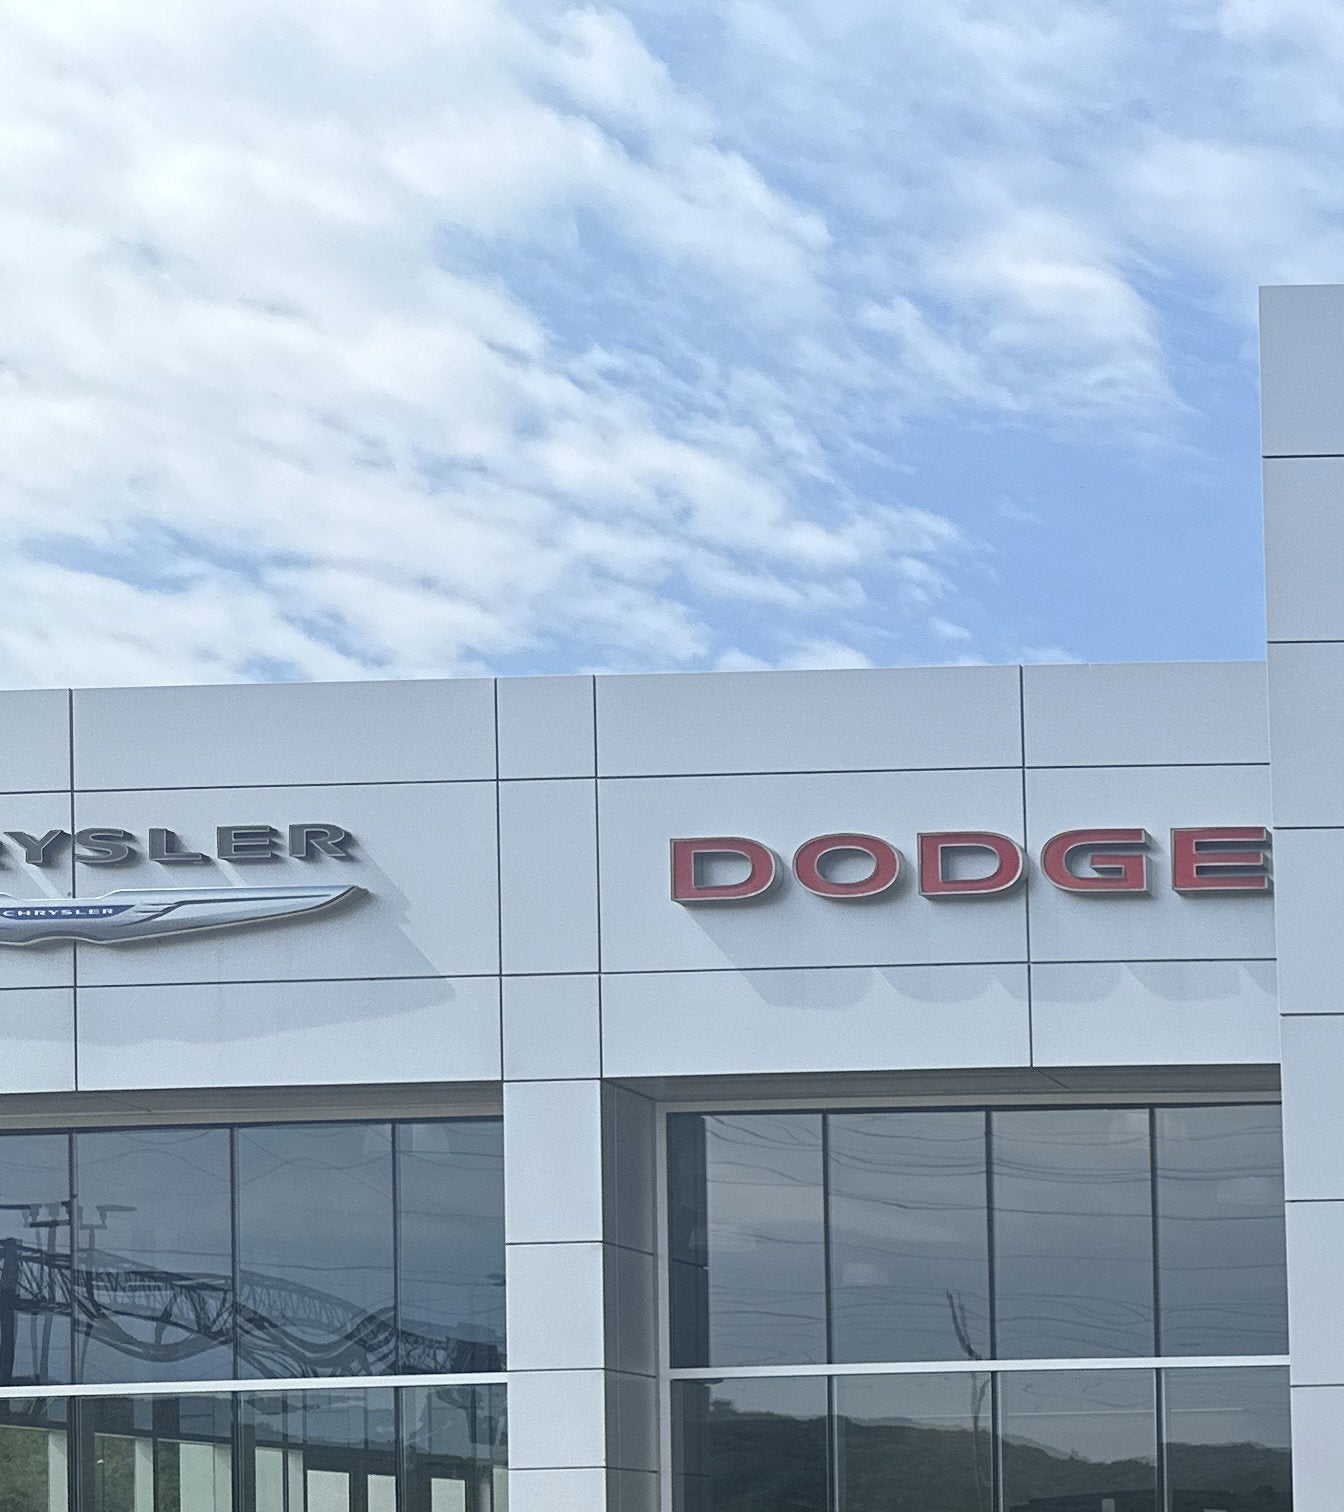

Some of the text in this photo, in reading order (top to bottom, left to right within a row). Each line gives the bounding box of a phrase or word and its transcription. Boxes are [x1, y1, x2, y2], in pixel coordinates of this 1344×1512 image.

[0, 823, 354, 866] YSLER
[670, 826, 1274, 902] DODGE
[2, 908, 114, 917] CHRYSLER
